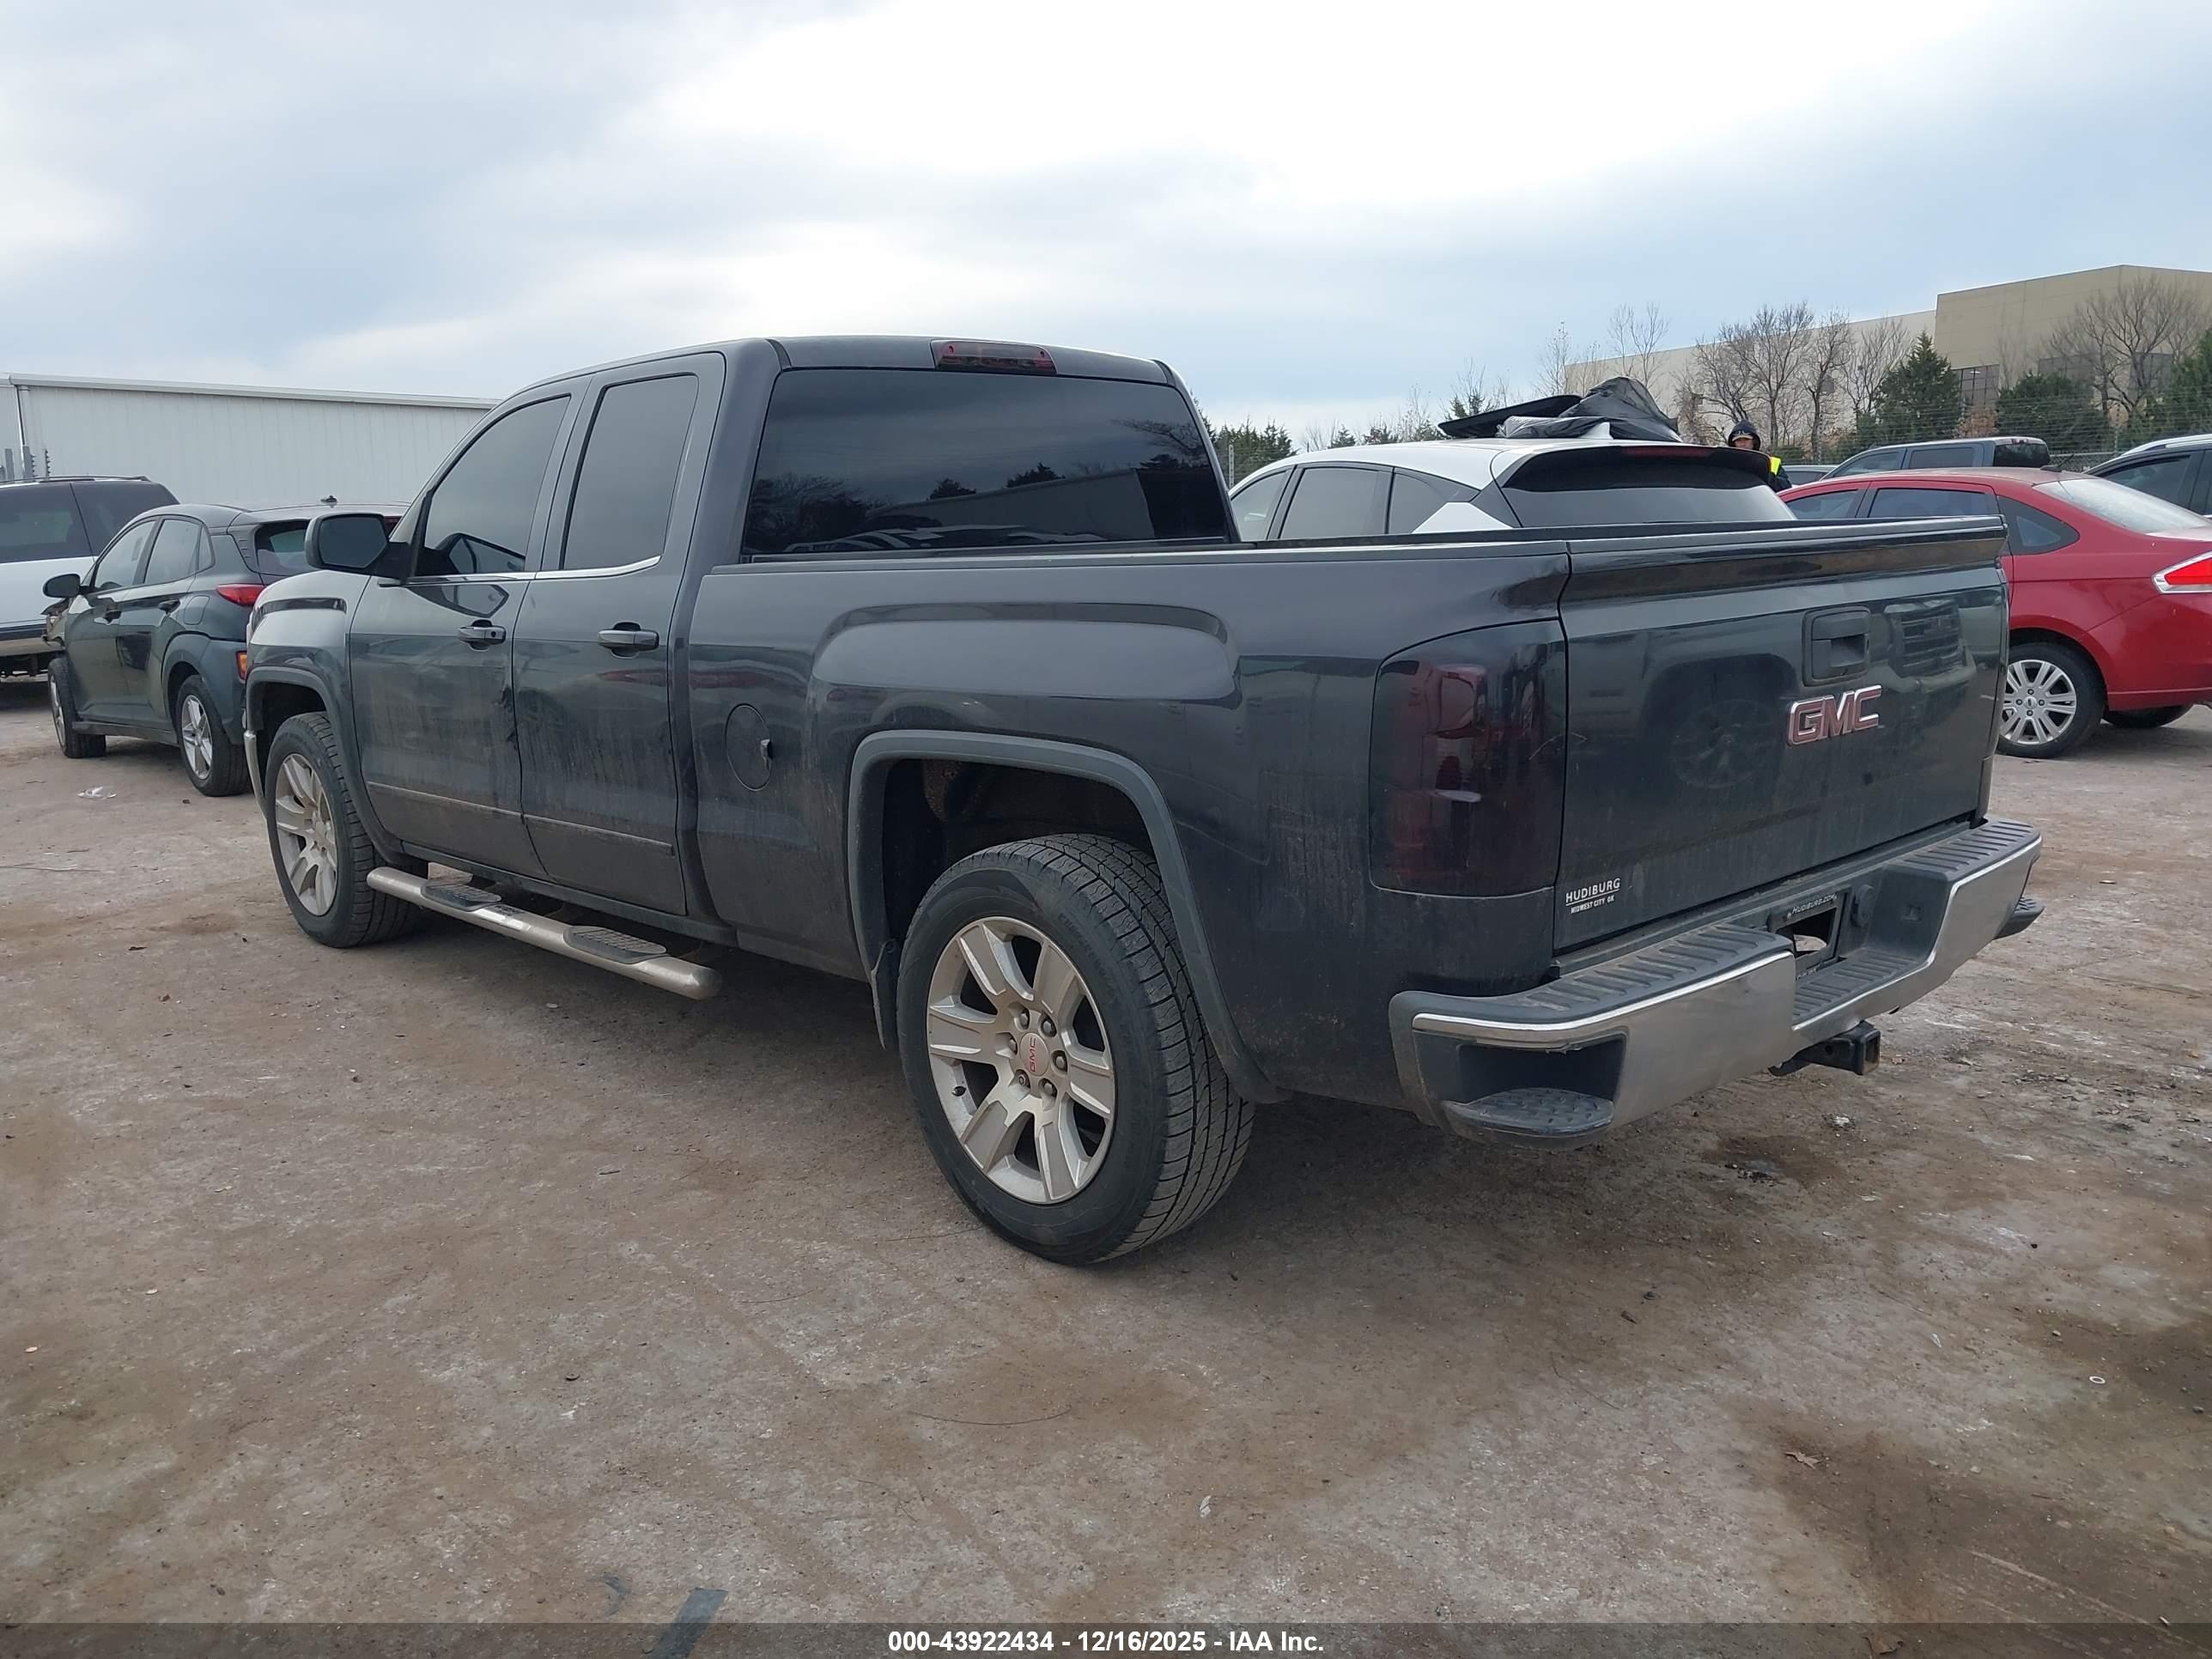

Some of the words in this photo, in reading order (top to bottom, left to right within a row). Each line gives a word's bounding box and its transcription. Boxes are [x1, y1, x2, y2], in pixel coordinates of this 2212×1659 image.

[1788, 685, 1882, 746] GMC
[1565, 878, 1620, 903] HUDIBURG
[1571, 901, 1593, 914] MIDWEST
[1594, 897, 1606, 907] CITY
